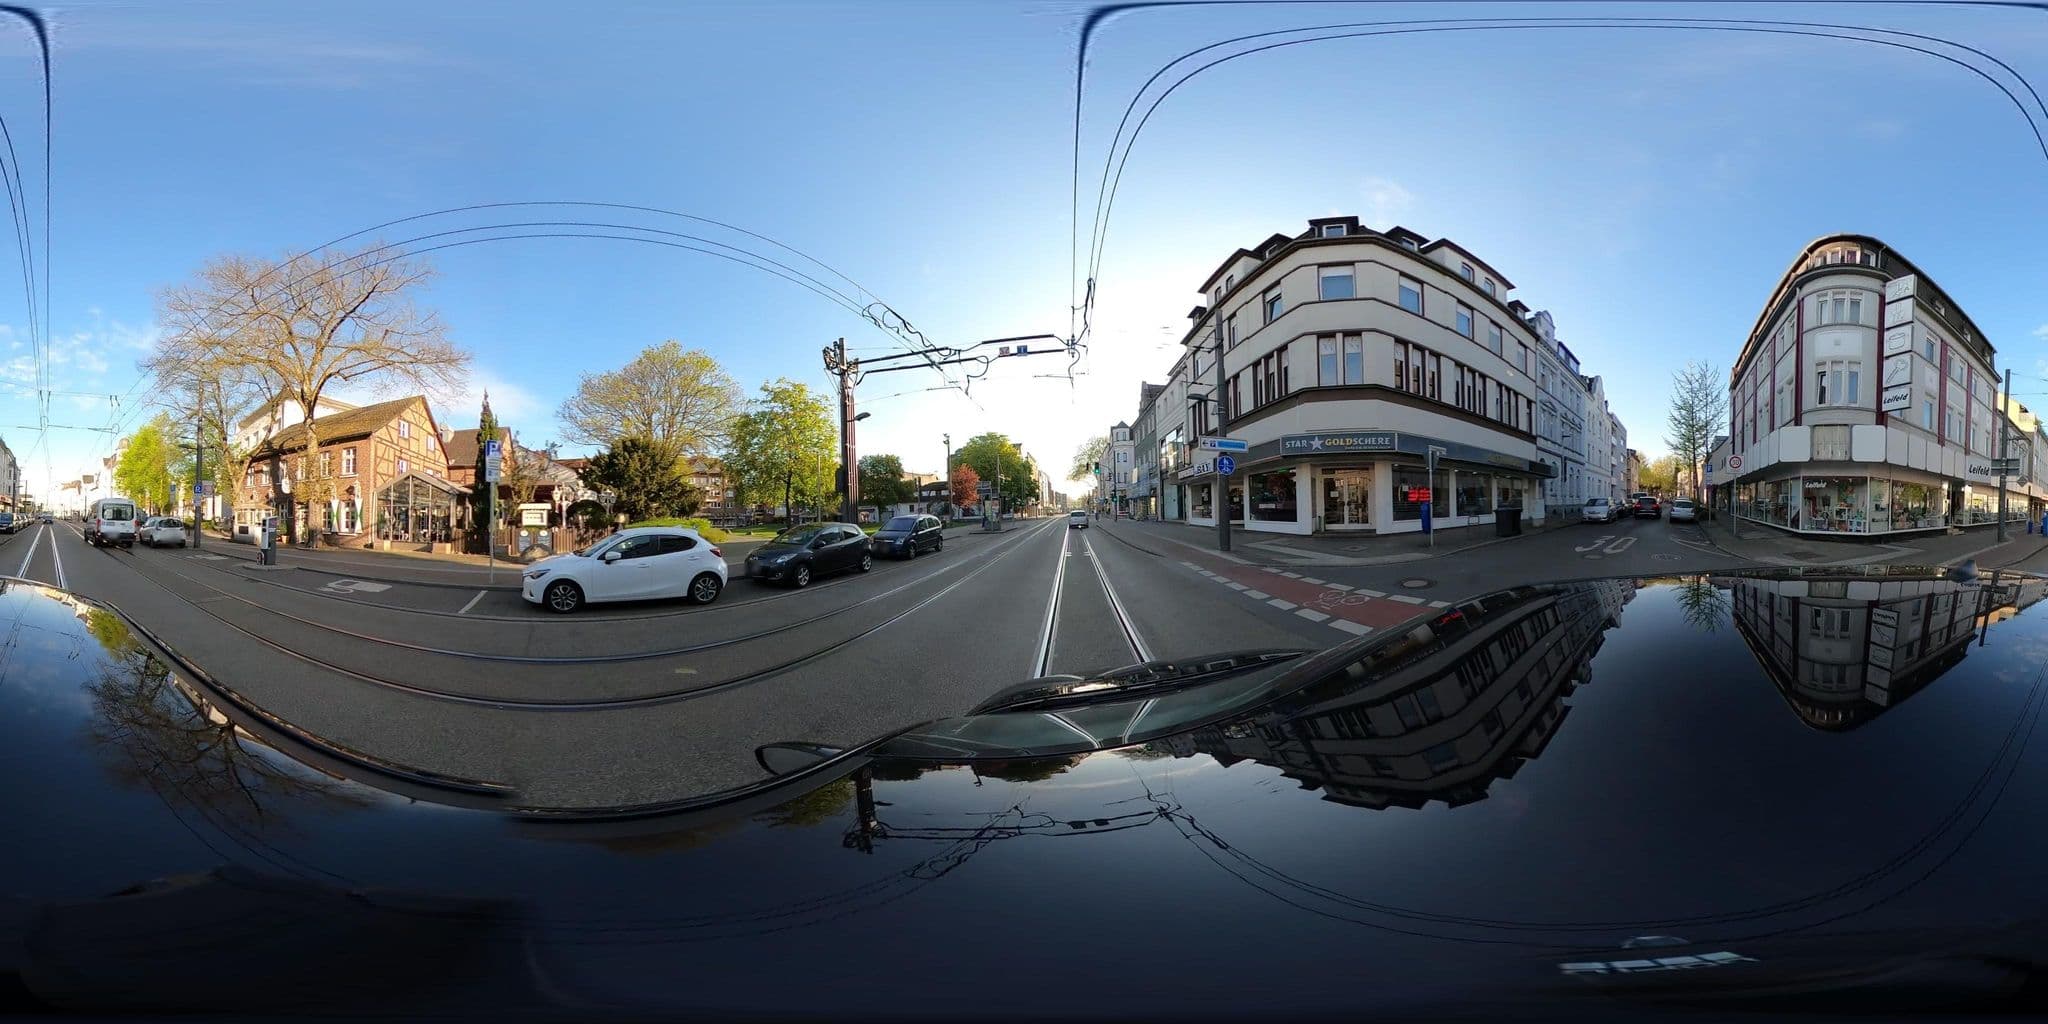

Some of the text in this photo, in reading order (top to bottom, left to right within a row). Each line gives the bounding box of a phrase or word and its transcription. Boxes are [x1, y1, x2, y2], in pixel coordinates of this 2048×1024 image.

[1883, 393, 1909, 404] Leifeld
[1285, 437, 1391, 449] STAR GOLDSCHERE
[1968, 464, 1991, 476] Leifeld
[1575, 535, 1638, 554] 30
